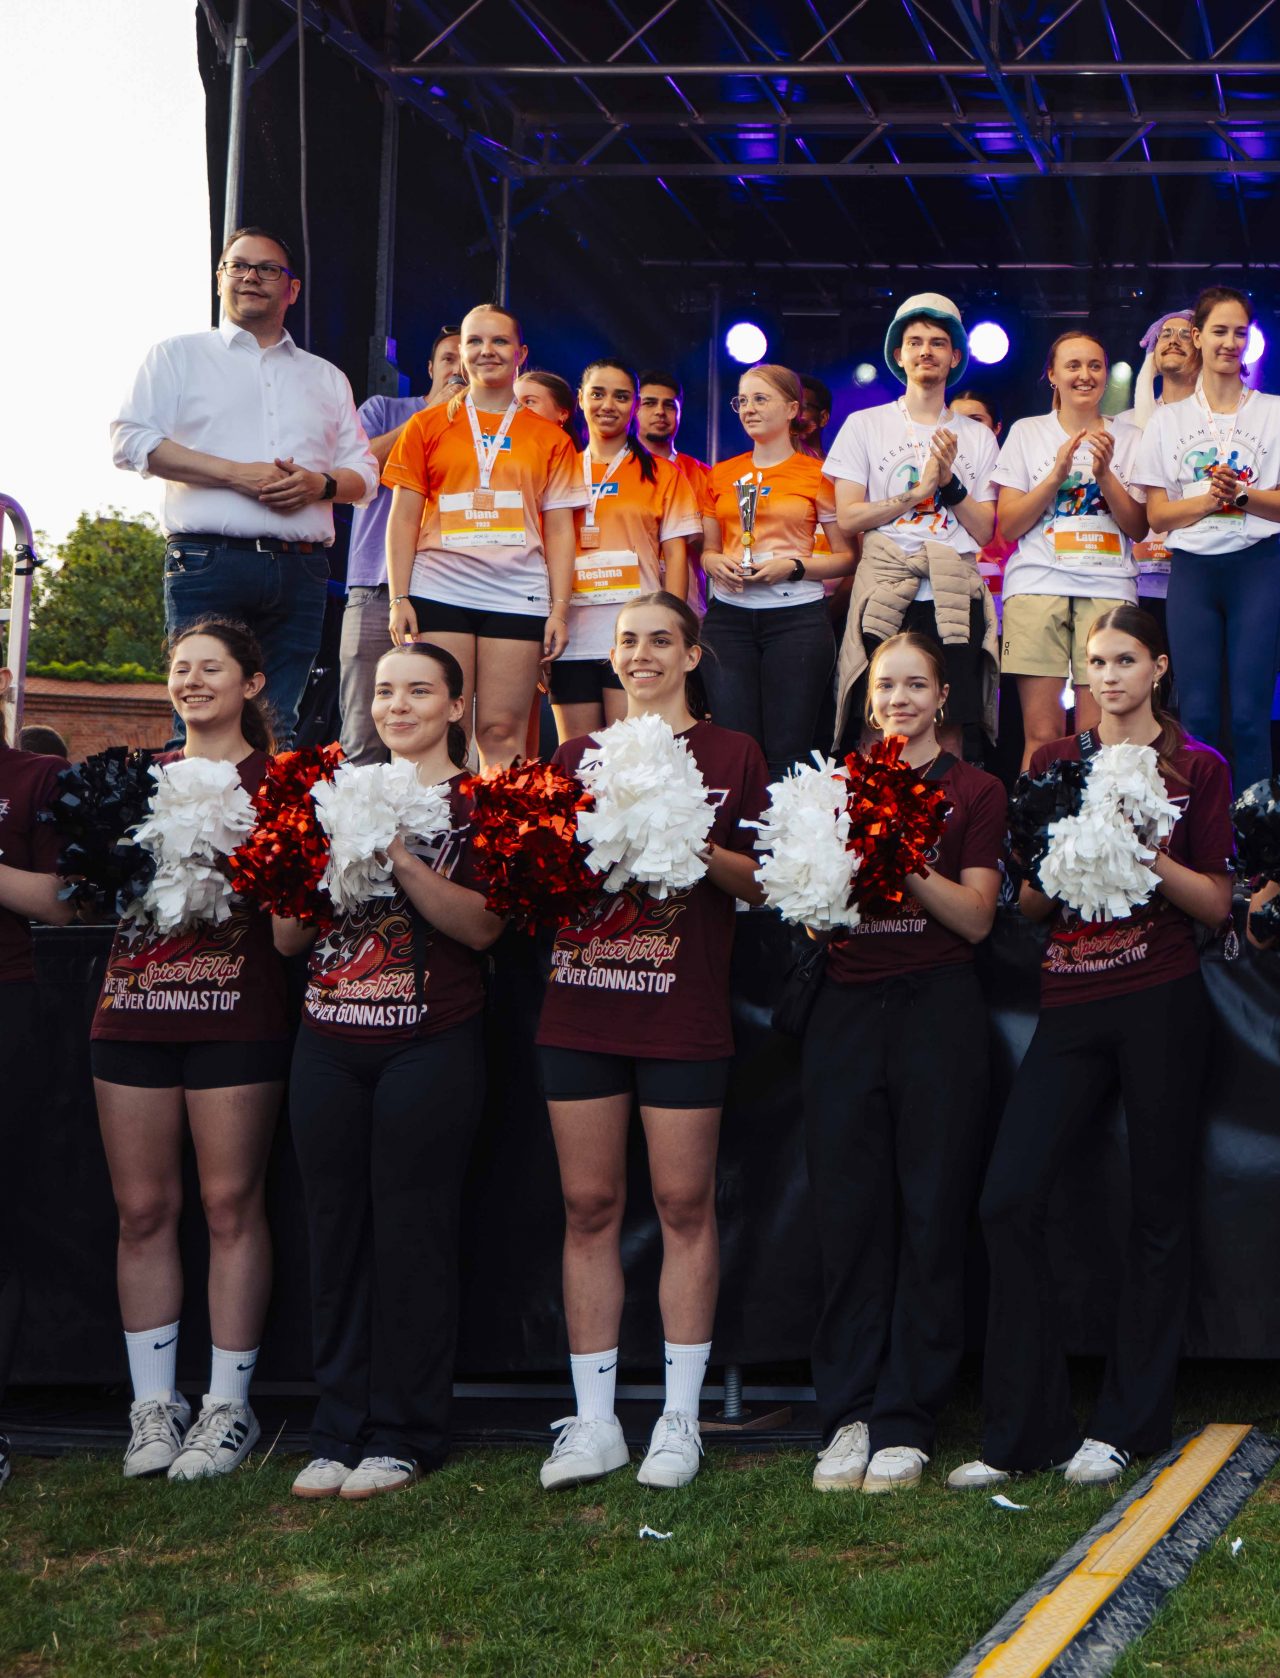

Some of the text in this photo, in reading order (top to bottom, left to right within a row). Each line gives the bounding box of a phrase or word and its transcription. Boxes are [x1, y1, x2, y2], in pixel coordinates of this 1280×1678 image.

[464, 509, 499, 520] Diana
[1075, 531, 1104, 542] Laura
[577, 568, 623, 580] Reshma
[581, 934, 680, 968] Spice It Up!
[138, 955, 246, 990] Spice It Up!
[555, 966, 587, 986] NEVER
[111, 993, 144, 1010] NEVER
